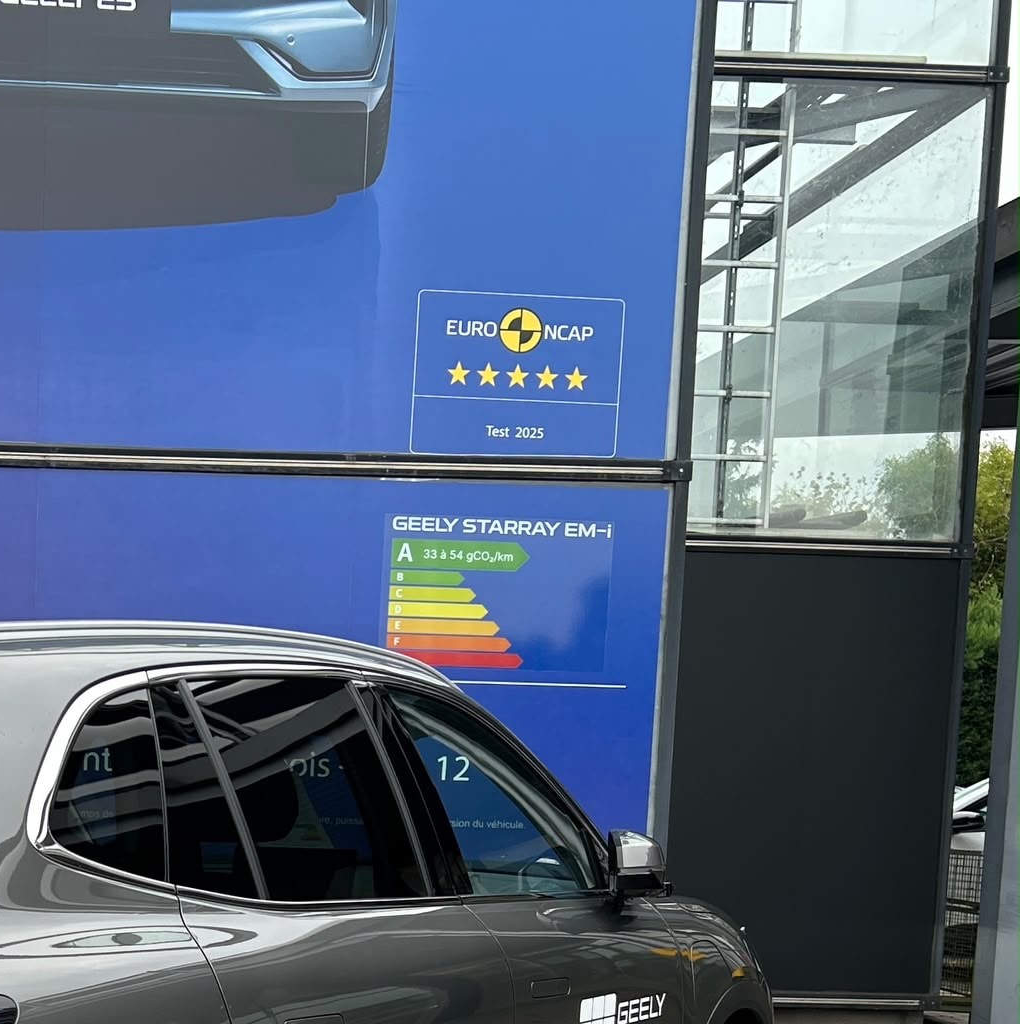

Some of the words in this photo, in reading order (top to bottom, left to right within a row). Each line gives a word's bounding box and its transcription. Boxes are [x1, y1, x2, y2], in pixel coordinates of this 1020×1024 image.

[446, 319, 497, 337] EURO
[544, 324, 594, 341] NCAP
[485, 425, 509, 437] Test
[515, 427, 544, 438] 2025
[392, 516, 459, 532] GEELY
[462, 519, 560, 537] STARRAY
[564, 522, 612, 539] EM-i
[397, 543, 413, 562] A
[423, 549, 437, 559] 33
[440, 547, 447, 559] à
[450, 551, 464, 560] 54
[396, 573, 404, 581] B
[395, 589, 403, 598] C
[395, 606, 402, 614] D
[394, 621, 401, 630] E
[393, 637, 400, 646] F
[83, 747, 113, 772] nt
[284, 751, 330, 777] ois
[437, 756, 470, 781] 12
[472, 819, 484, 829] du
